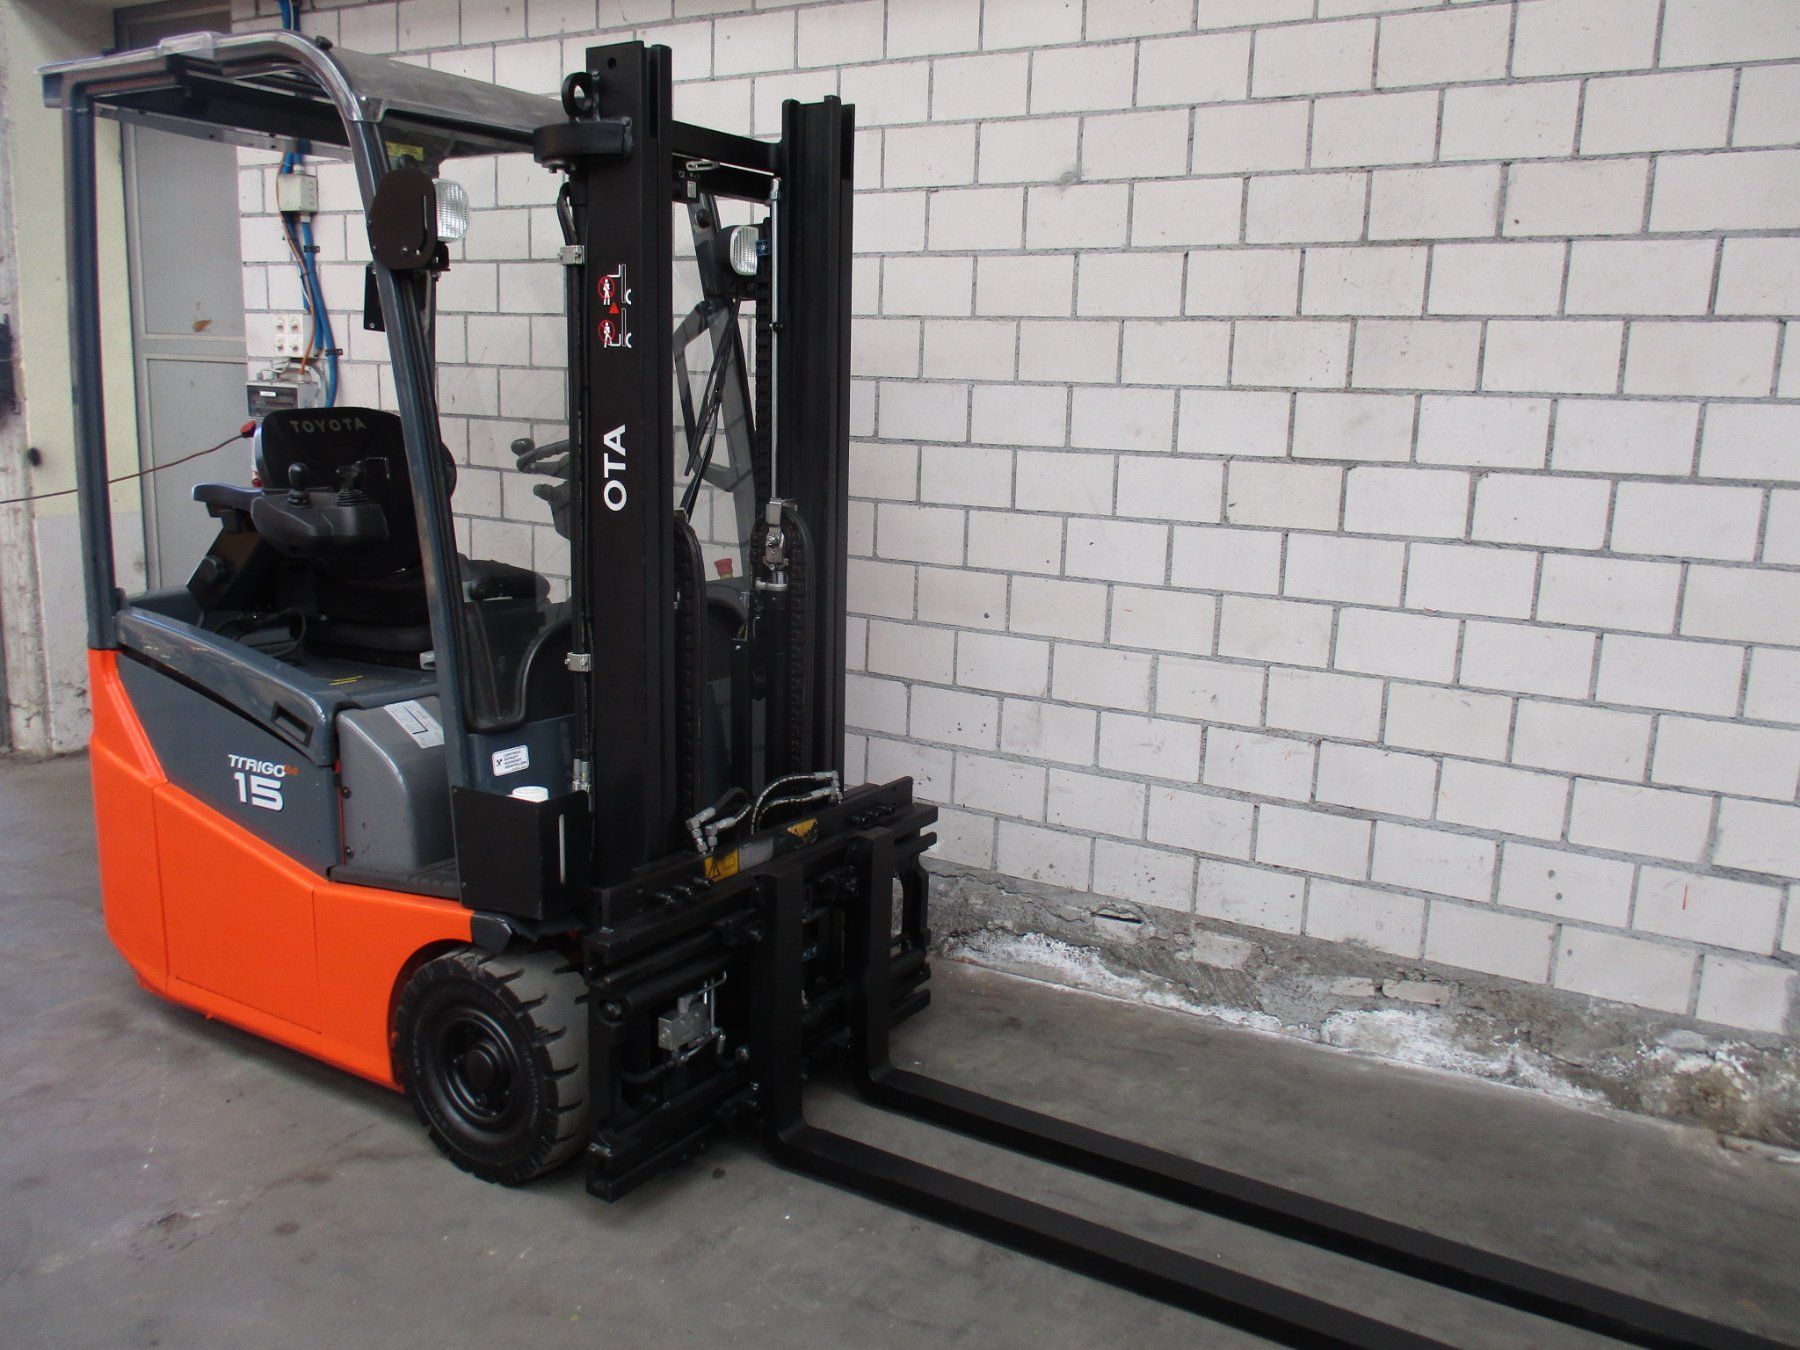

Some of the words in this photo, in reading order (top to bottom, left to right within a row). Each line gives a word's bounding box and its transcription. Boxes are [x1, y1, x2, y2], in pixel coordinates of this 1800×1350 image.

[289, 417, 366, 433] TOYOTA
[603, 424, 627, 511] OTA
[234, 772, 283, 811] 15
